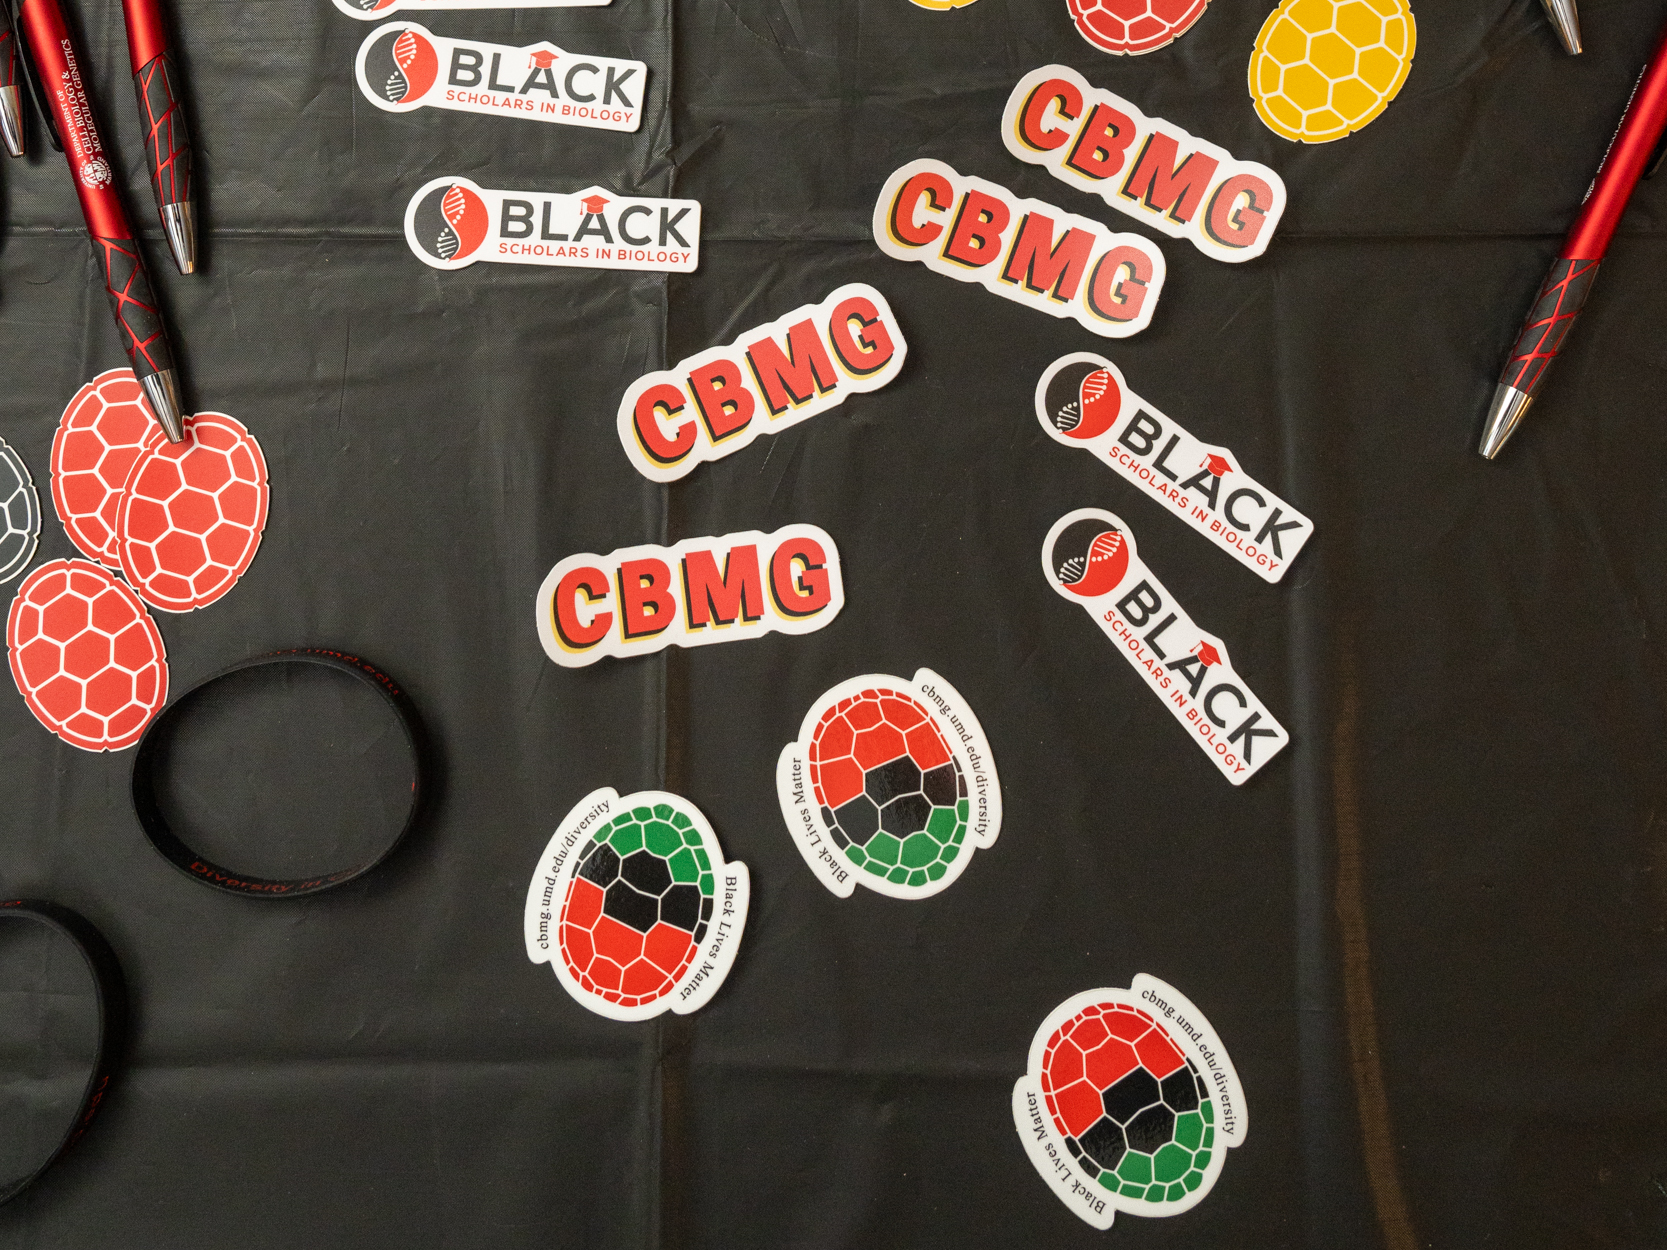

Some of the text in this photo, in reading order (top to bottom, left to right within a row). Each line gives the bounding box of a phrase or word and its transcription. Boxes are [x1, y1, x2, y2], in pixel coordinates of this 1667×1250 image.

[56, 90, 84, 158] DEPARTMENT OF
[60, 38, 103, 152] MOLECULAR GENETICS
[61, 71, 94, 155] CELL BIOLOGY &
[446, 89, 633, 124] SCHOLARS IN BIOLOGY
[447, 47, 638, 108] BLACK
[499, 199, 692, 248] BLACK
[1013, 78, 1274, 249] CBMG
[498, 242, 691, 264] SCHOLARS IN BIOLOGY
[886, 171, 1153, 323] CBMG
[631, 296, 896, 469] CBMG
[1109, 445, 1279, 573] SCHOLARS IN BIOLOGY
[1117, 408, 1303, 560] BLACK
[549, 536, 832, 654] CBMG
[1104, 610, 1245, 776] SCHOLARS IN BIOLOGY
[1114, 579, 1279, 765] BLACK
[792, 757, 850, 884] Black Lives Matter
[921, 682, 987, 838] cbmg.umd.edu/diversity
[538, 799, 611, 950] cbmg.umd.edu/diversity
[680, 876, 737, 1001] Black Lives Matter
[1142, 988, 1235, 1135] cbmg.umd.edu/diversity
[1027, 1091, 1106, 1214] Black Lives Matter
